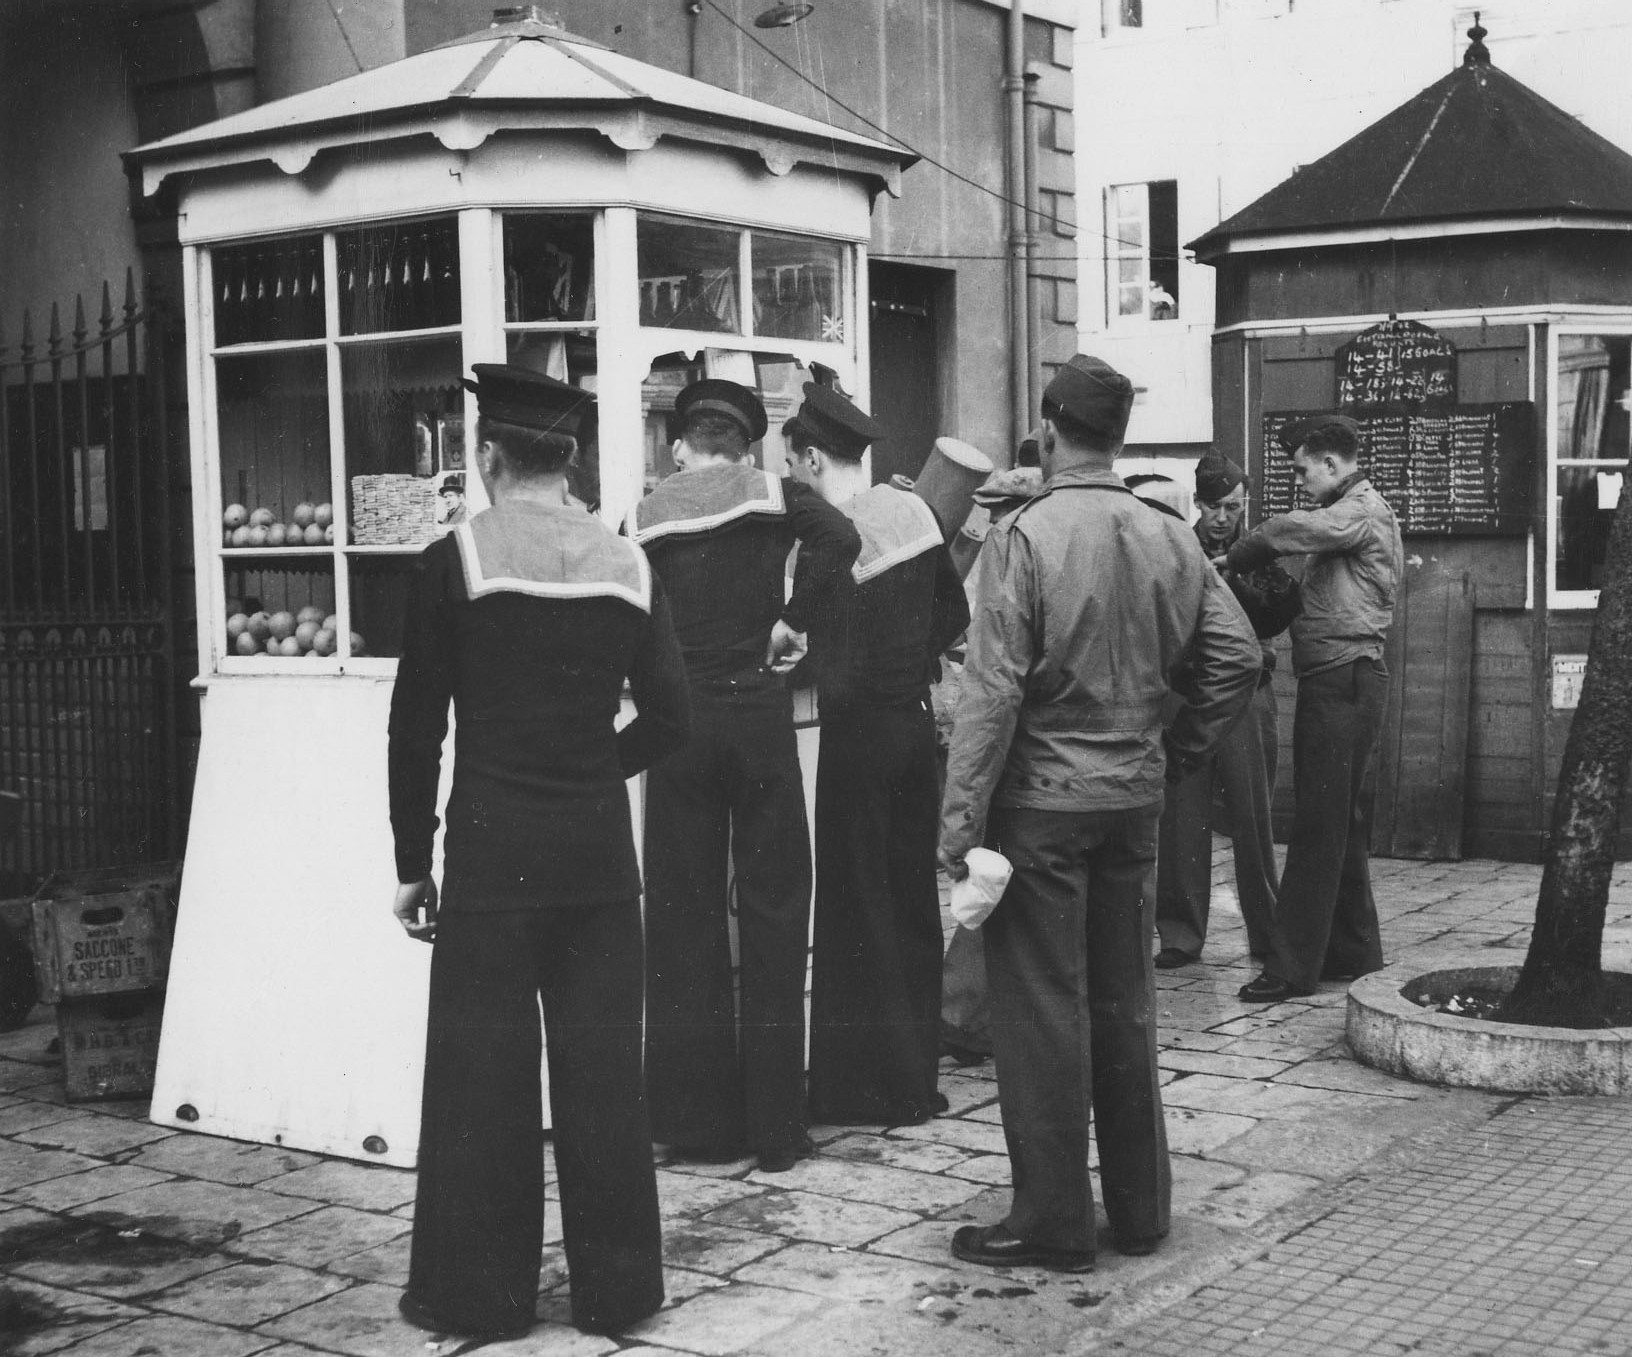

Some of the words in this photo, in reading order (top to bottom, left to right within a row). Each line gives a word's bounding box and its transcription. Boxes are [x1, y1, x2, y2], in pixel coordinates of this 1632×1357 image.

[74, 936, 135, 961] SACCONE
[67, 963, 77, 983] &
[80, 959, 122, 981] SPEED
